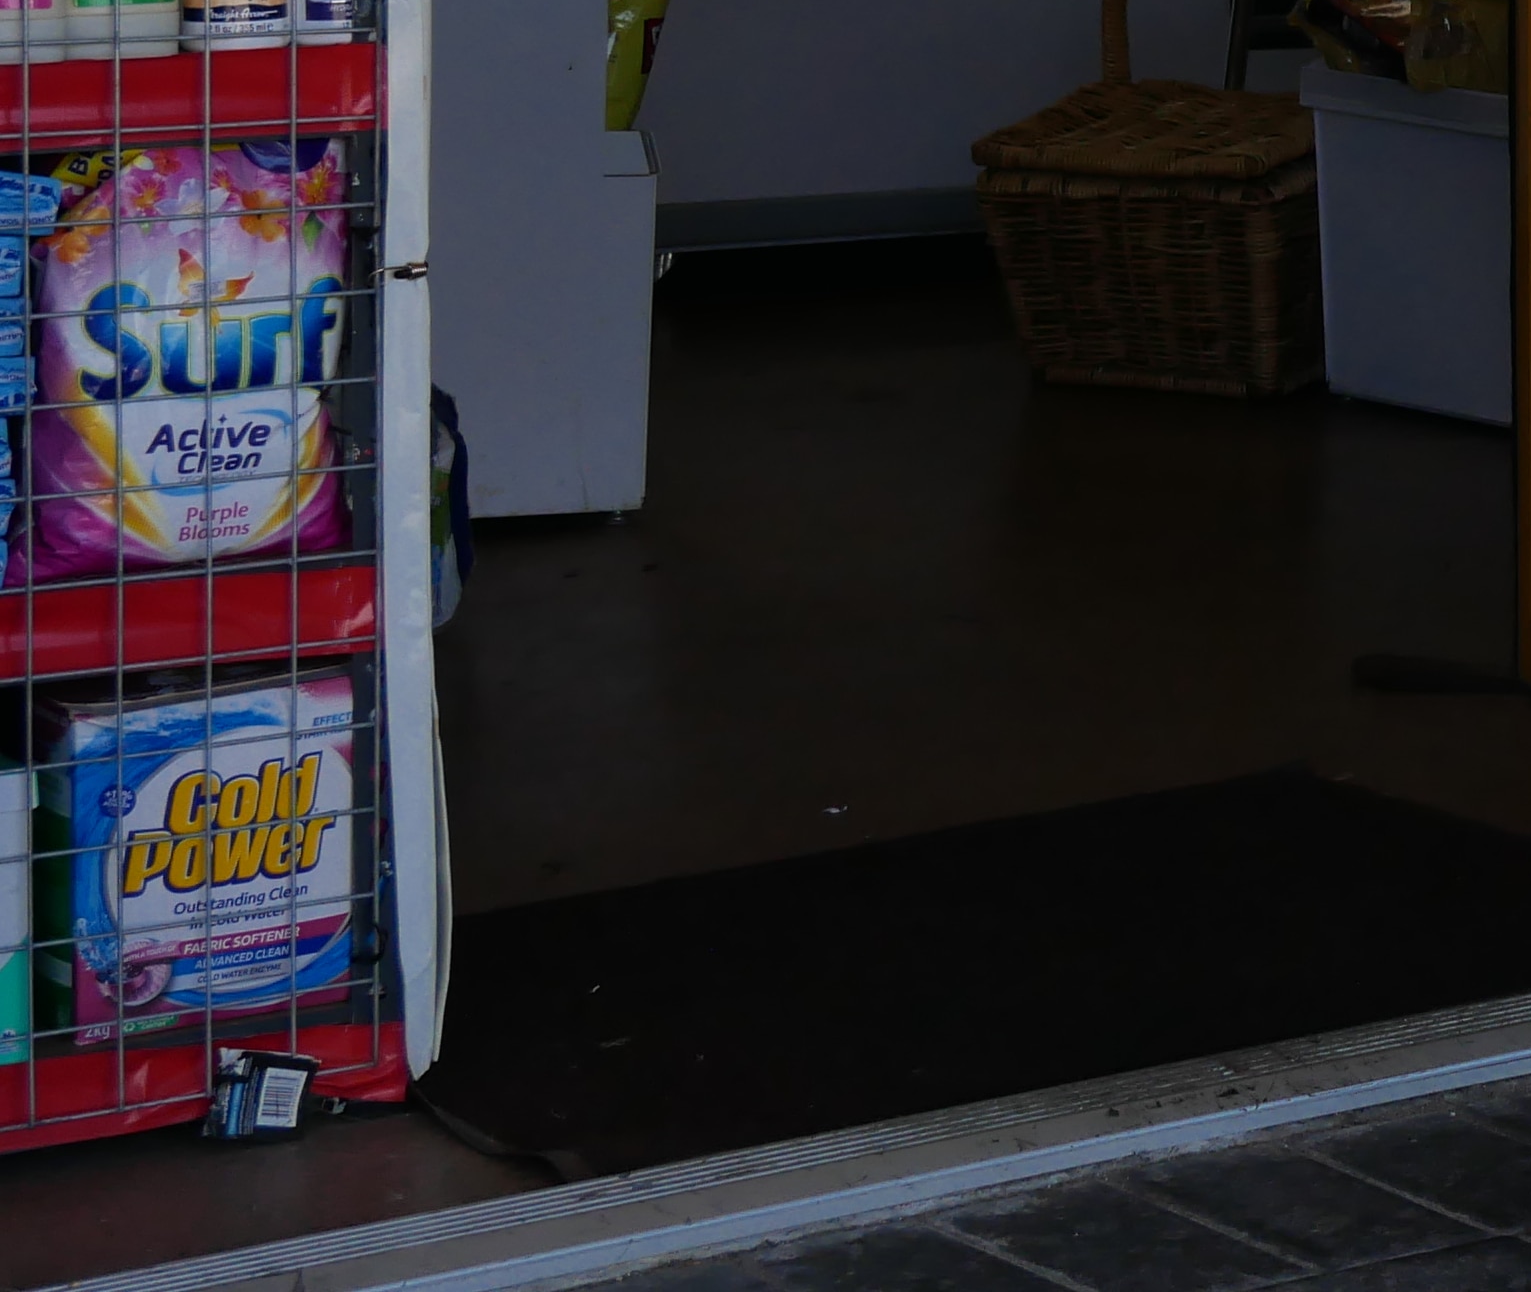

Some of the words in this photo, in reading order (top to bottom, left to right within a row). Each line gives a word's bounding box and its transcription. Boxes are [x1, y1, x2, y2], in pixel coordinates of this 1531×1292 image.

[78, 274, 343, 402] Surf
[146, 414, 271, 455] Active
[177, 450, 262, 475] Clean
[186, 501, 249, 524] Purple
[178, 520, 250, 542] Blooms
[313, 712, 352, 727] EFFECT
[165, 751, 323, 836] Cold
[122, 816, 335, 898] Power
[173, 893, 265, 916] Outstanding
[269, 884, 308, 902] Clean
[233, 927, 300, 947] SOFTENER
[256, 945, 290, 960] CLEAN
[220, 968, 248, 981] WATER
